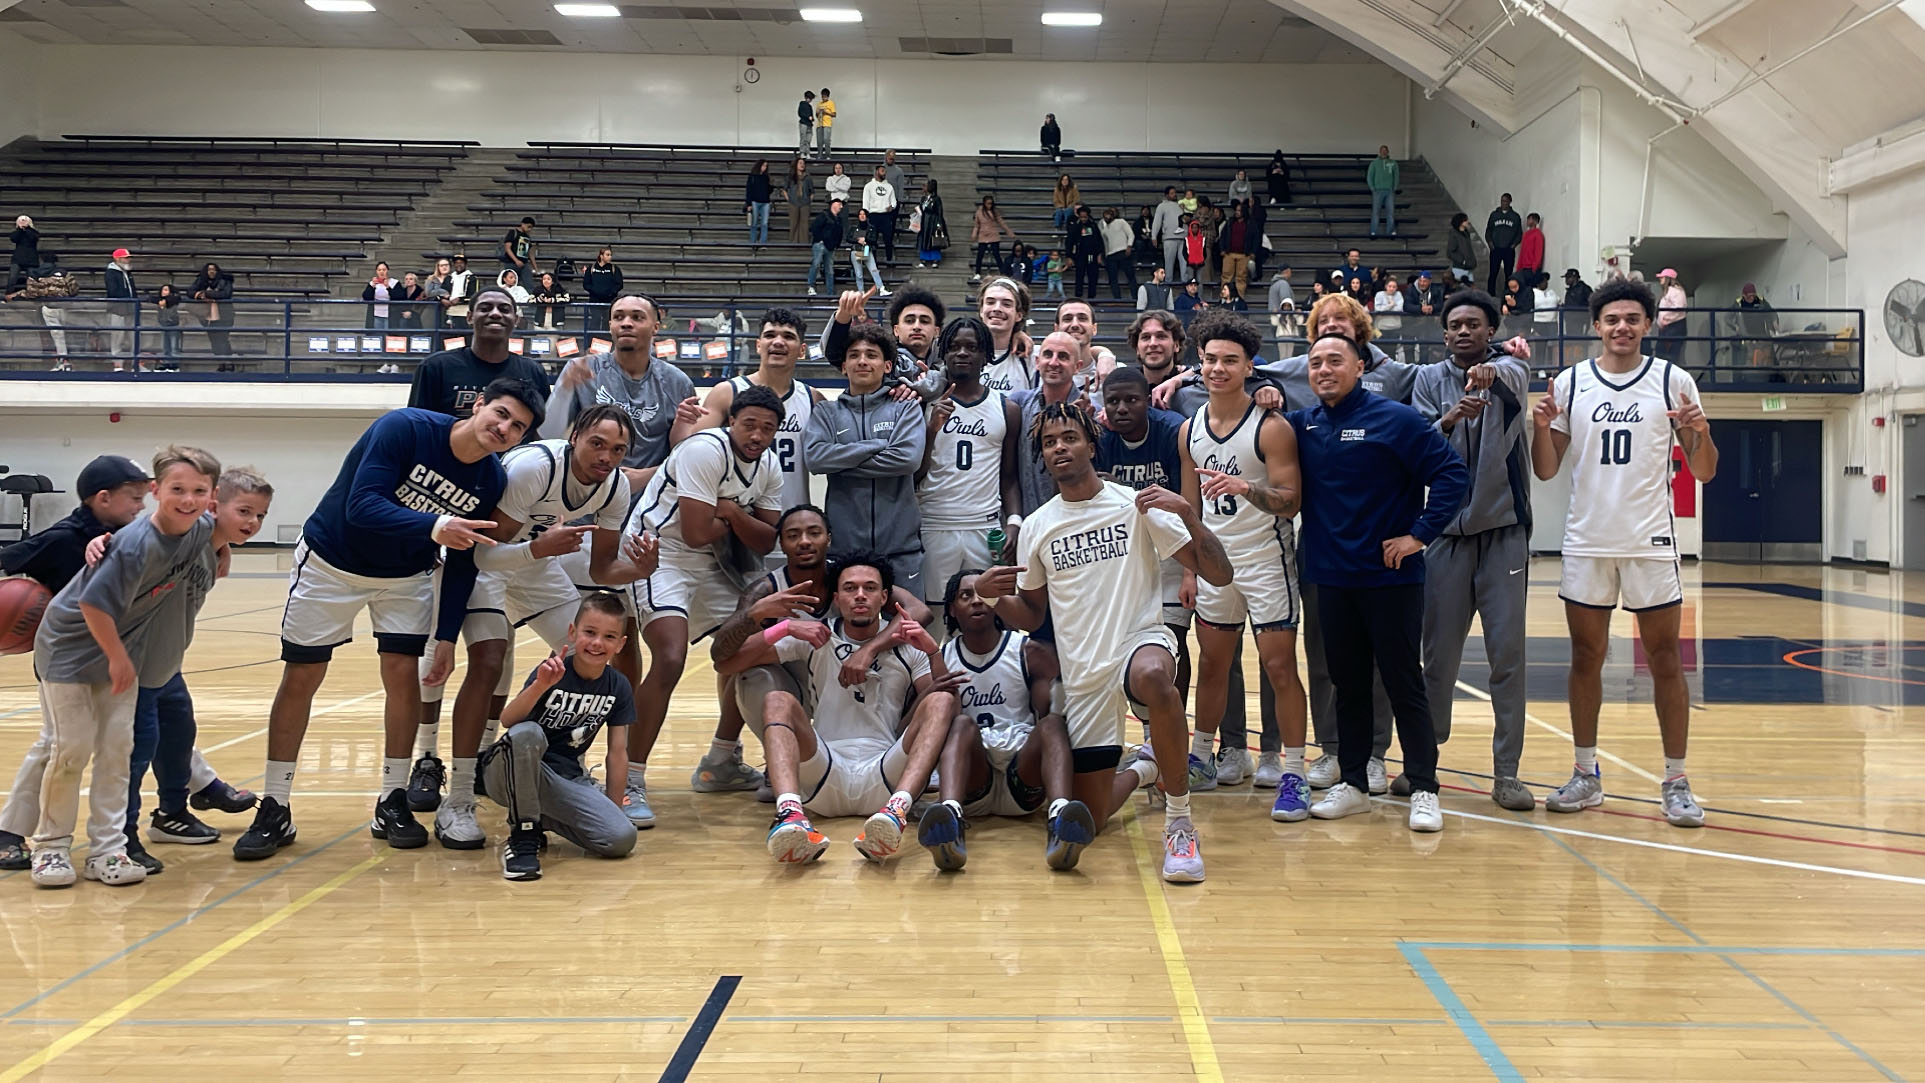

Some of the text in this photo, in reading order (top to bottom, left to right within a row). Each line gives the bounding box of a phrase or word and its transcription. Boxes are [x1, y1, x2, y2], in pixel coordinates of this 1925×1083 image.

[777, 413, 802, 433] ls
[1591, 401, 1644, 423] Owls
[943, 416, 988, 437] Owls
[1341, 428, 1366, 437] CITRUS
[956, 440, 973, 471] 0
[1600, 429, 1632, 465] 10
[1111, 461, 1165, 482] CTRUS
[1050, 523, 1129, 556] CITRUS
[1052, 540, 1129, 572] BASKETBALL
[545, 688, 617, 716] CITRUS
[960, 682, 1007, 709] Owls
